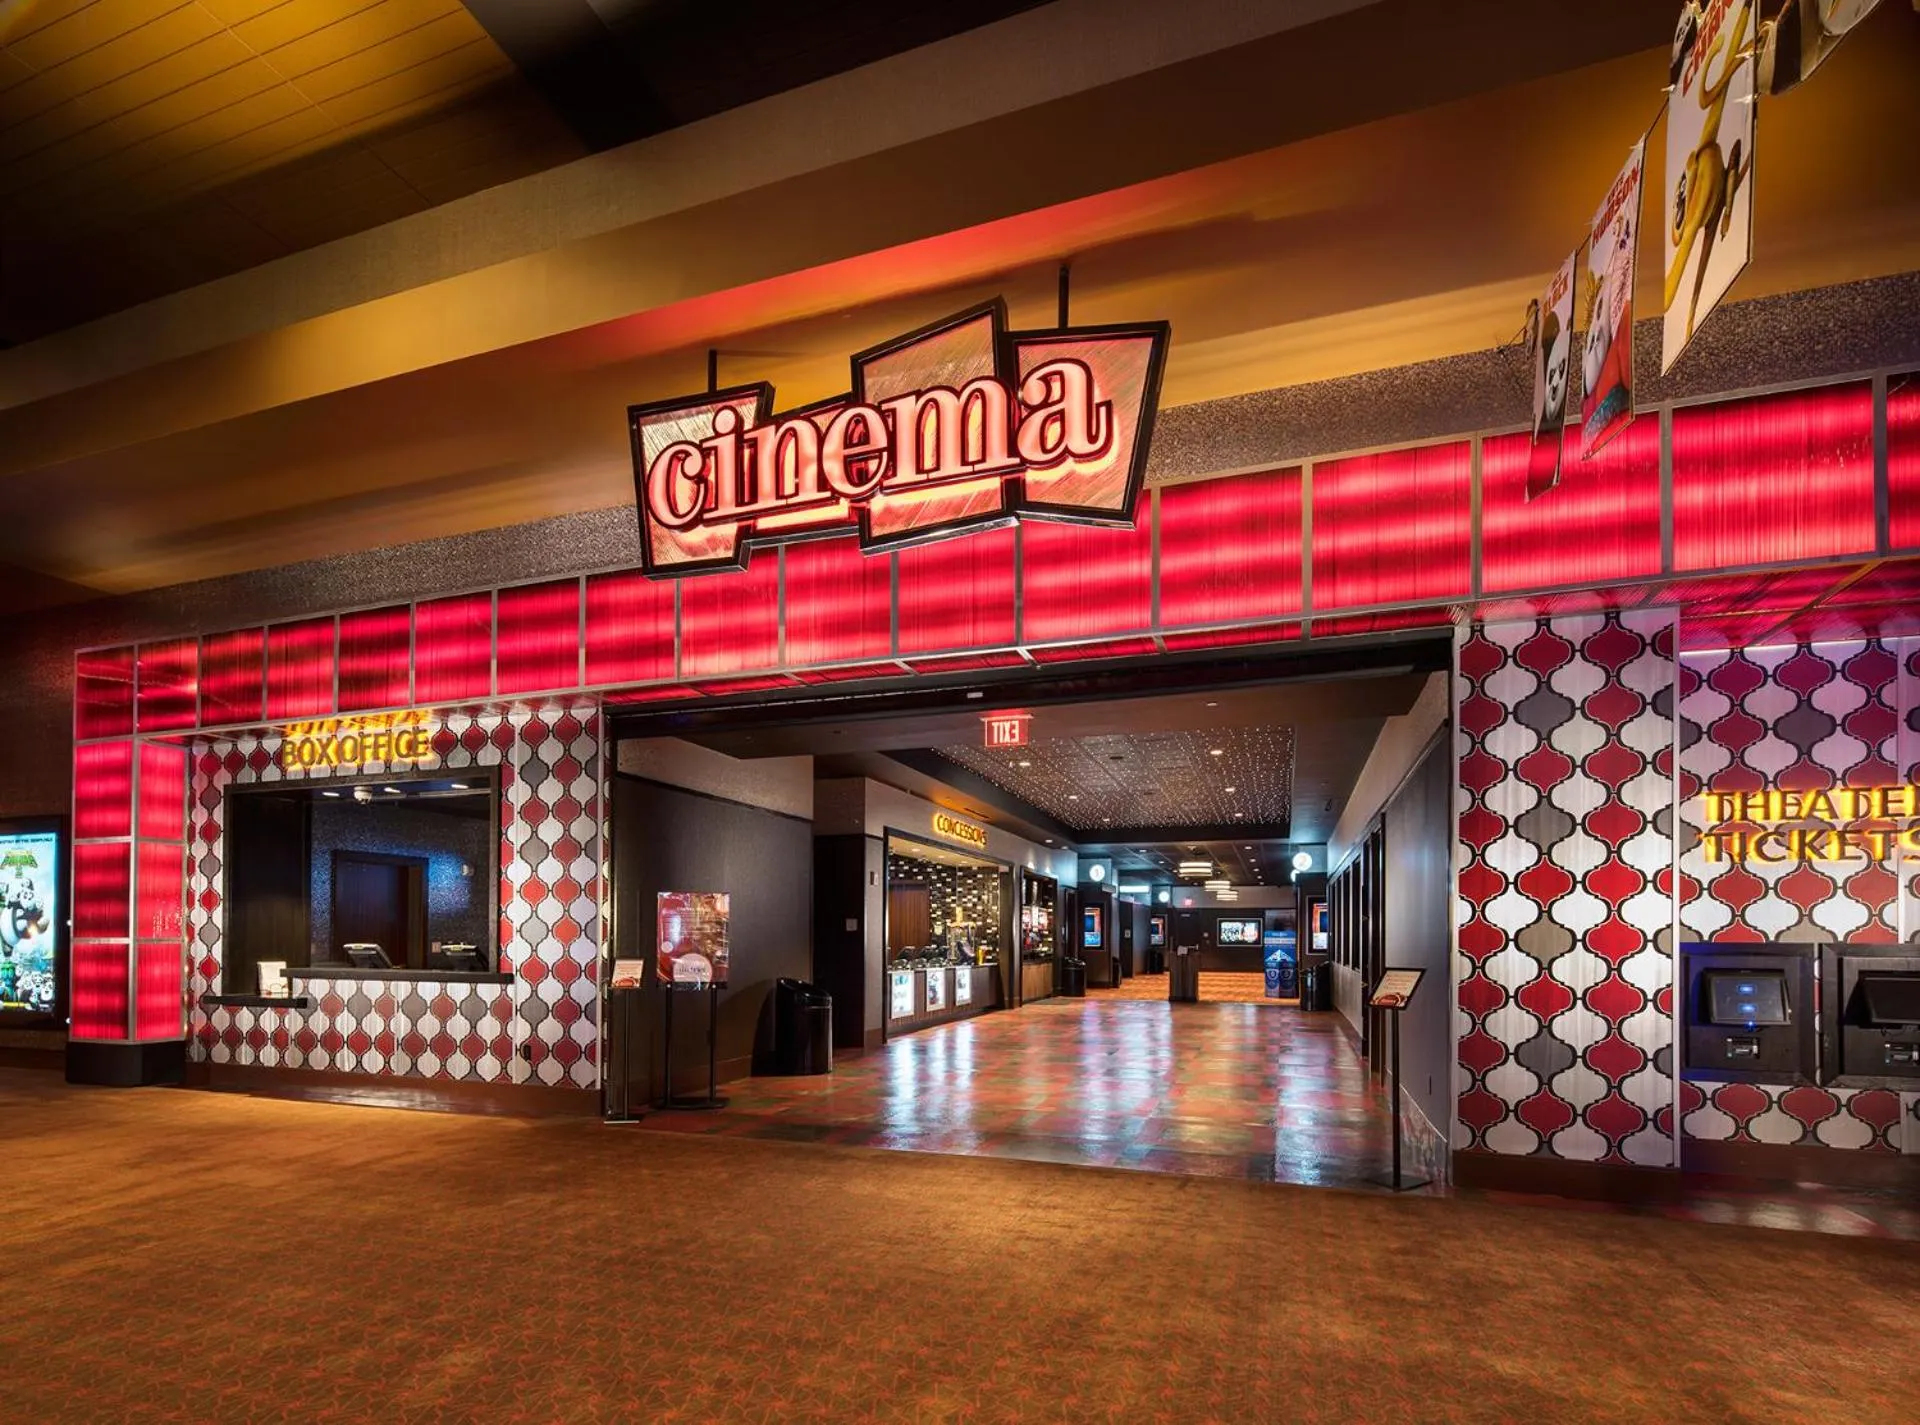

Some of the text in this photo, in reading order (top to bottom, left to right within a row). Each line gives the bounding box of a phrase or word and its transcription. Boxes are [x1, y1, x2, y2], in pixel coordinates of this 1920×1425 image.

[646, 357, 1112, 530] cinema
[283, 728, 428, 767] BOX OFFICE
[1705, 785, 1920, 822] THEATE
